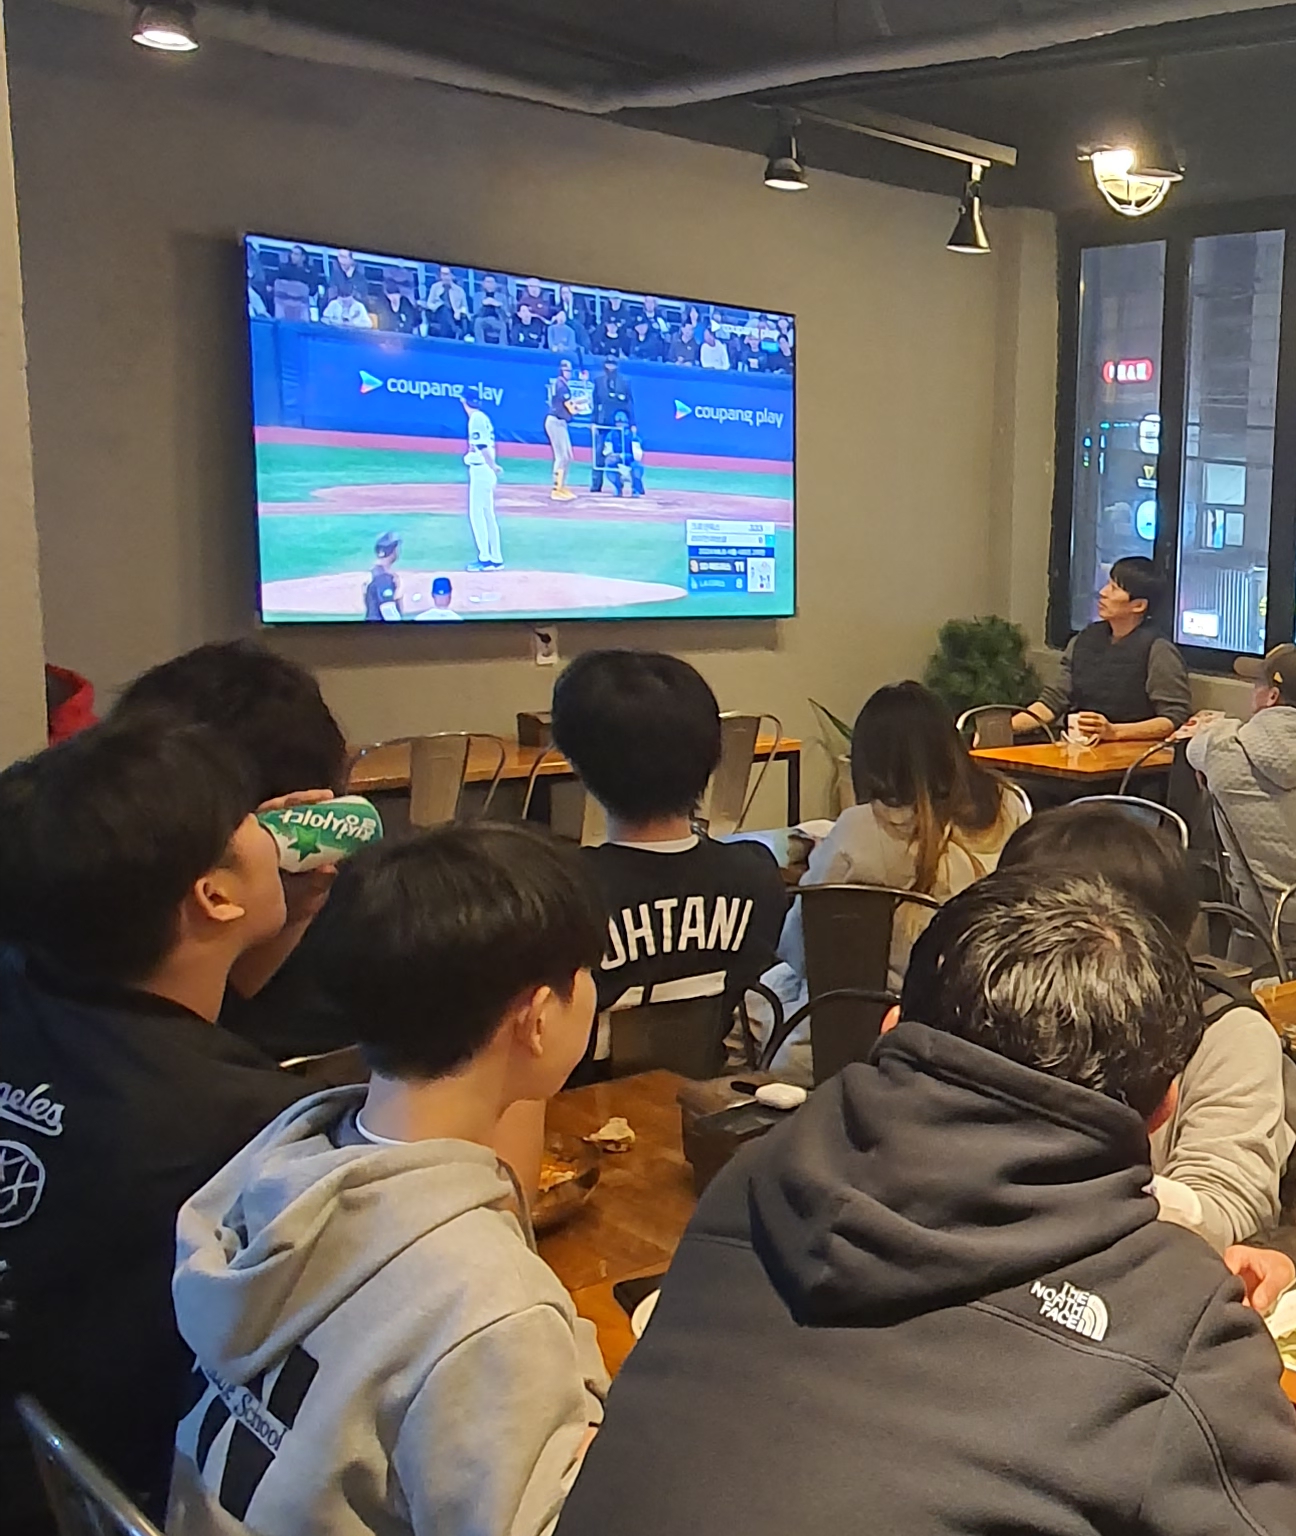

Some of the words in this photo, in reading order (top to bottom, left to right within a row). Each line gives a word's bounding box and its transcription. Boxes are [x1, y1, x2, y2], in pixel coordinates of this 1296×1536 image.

[387, 378, 464, 400] coupang
[468, 381, 504, 406] lay
[694, 405, 754, 426] coupang
[756, 407, 784, 428] play
[278, 808, 377, 842] 칠성사이다
[1030, 1280, 1085, 1320] NORTH
[1061, 1281, 1090, 1306] THE
[1039, 1300, 1079, 1330] FACE
[233, 1393, 288, 1452] School
